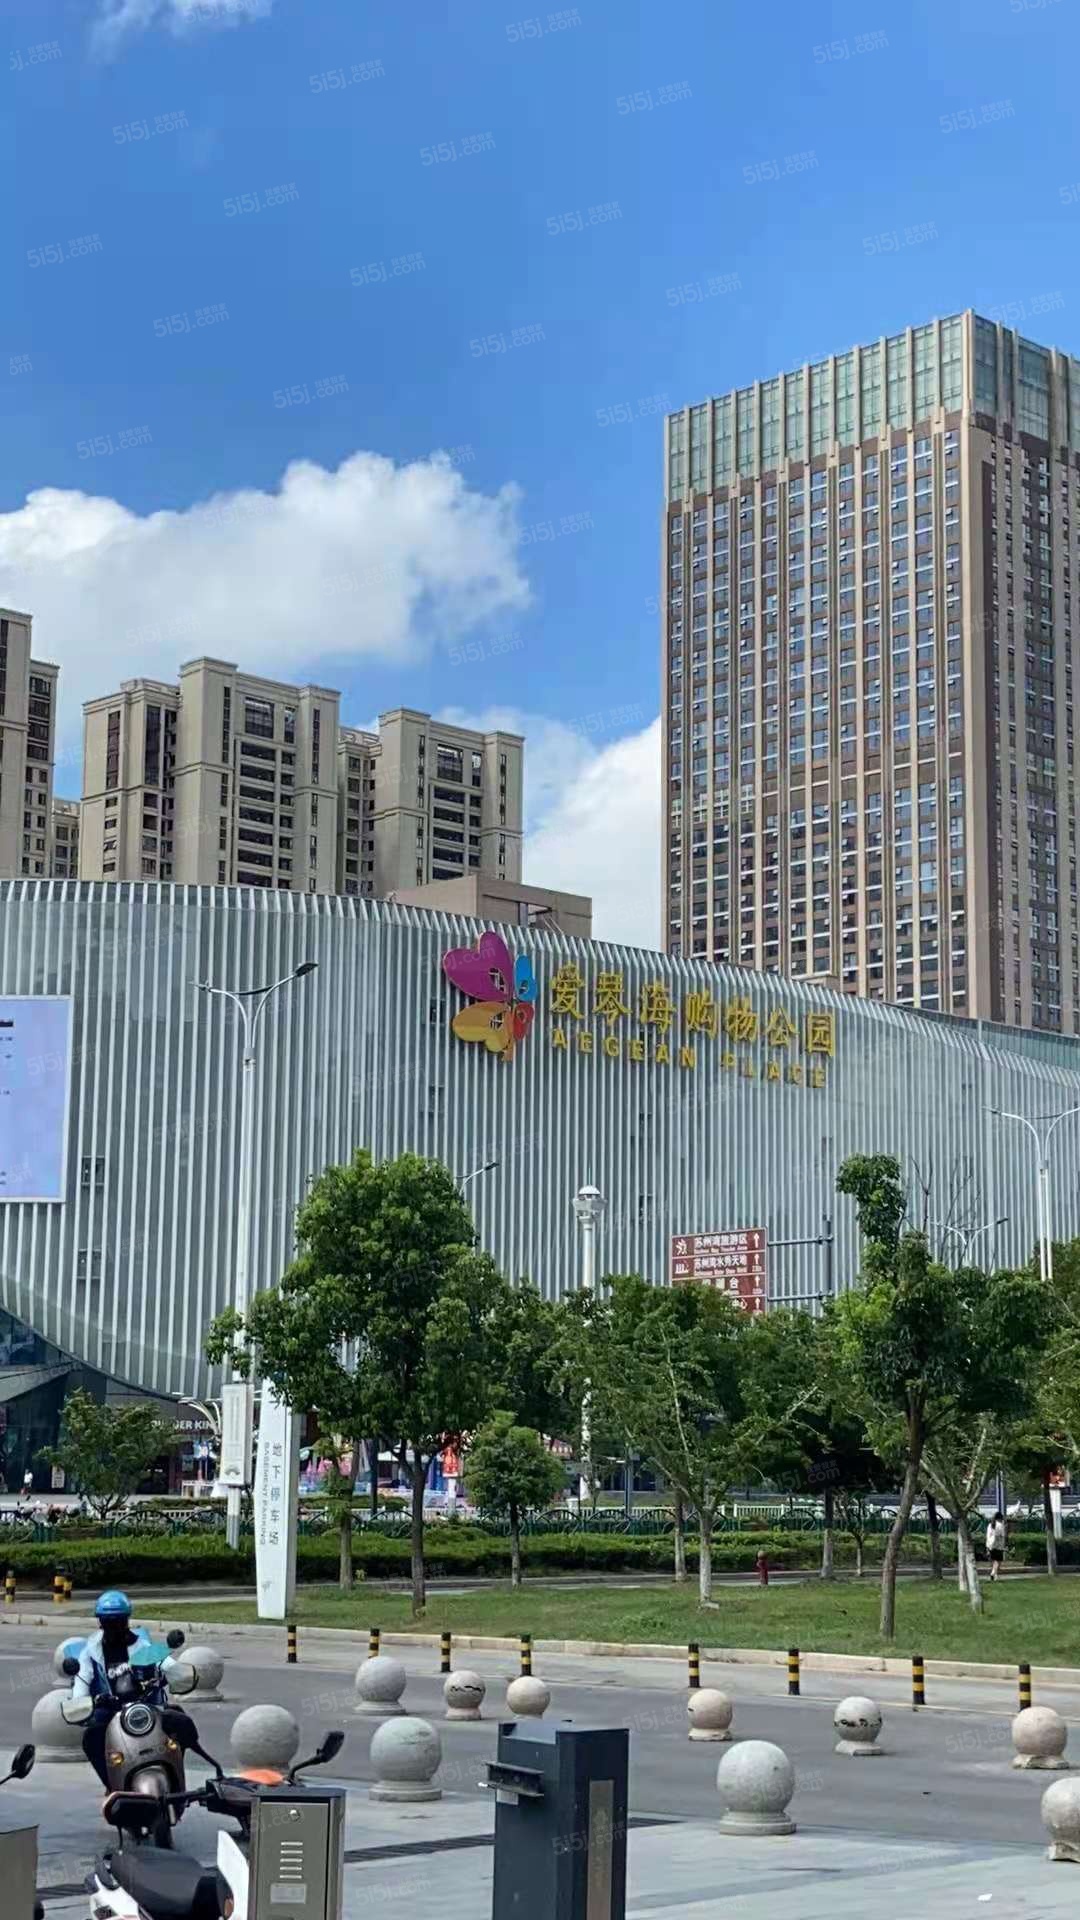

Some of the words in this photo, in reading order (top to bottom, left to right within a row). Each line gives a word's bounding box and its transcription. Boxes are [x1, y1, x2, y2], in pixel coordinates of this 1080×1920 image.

[549, 961, 835, 1058] 爱琴海购物公园
[552, 1027, 698, 1070] AEGEAN
[721, 1050, 827, 1089] PLACE
